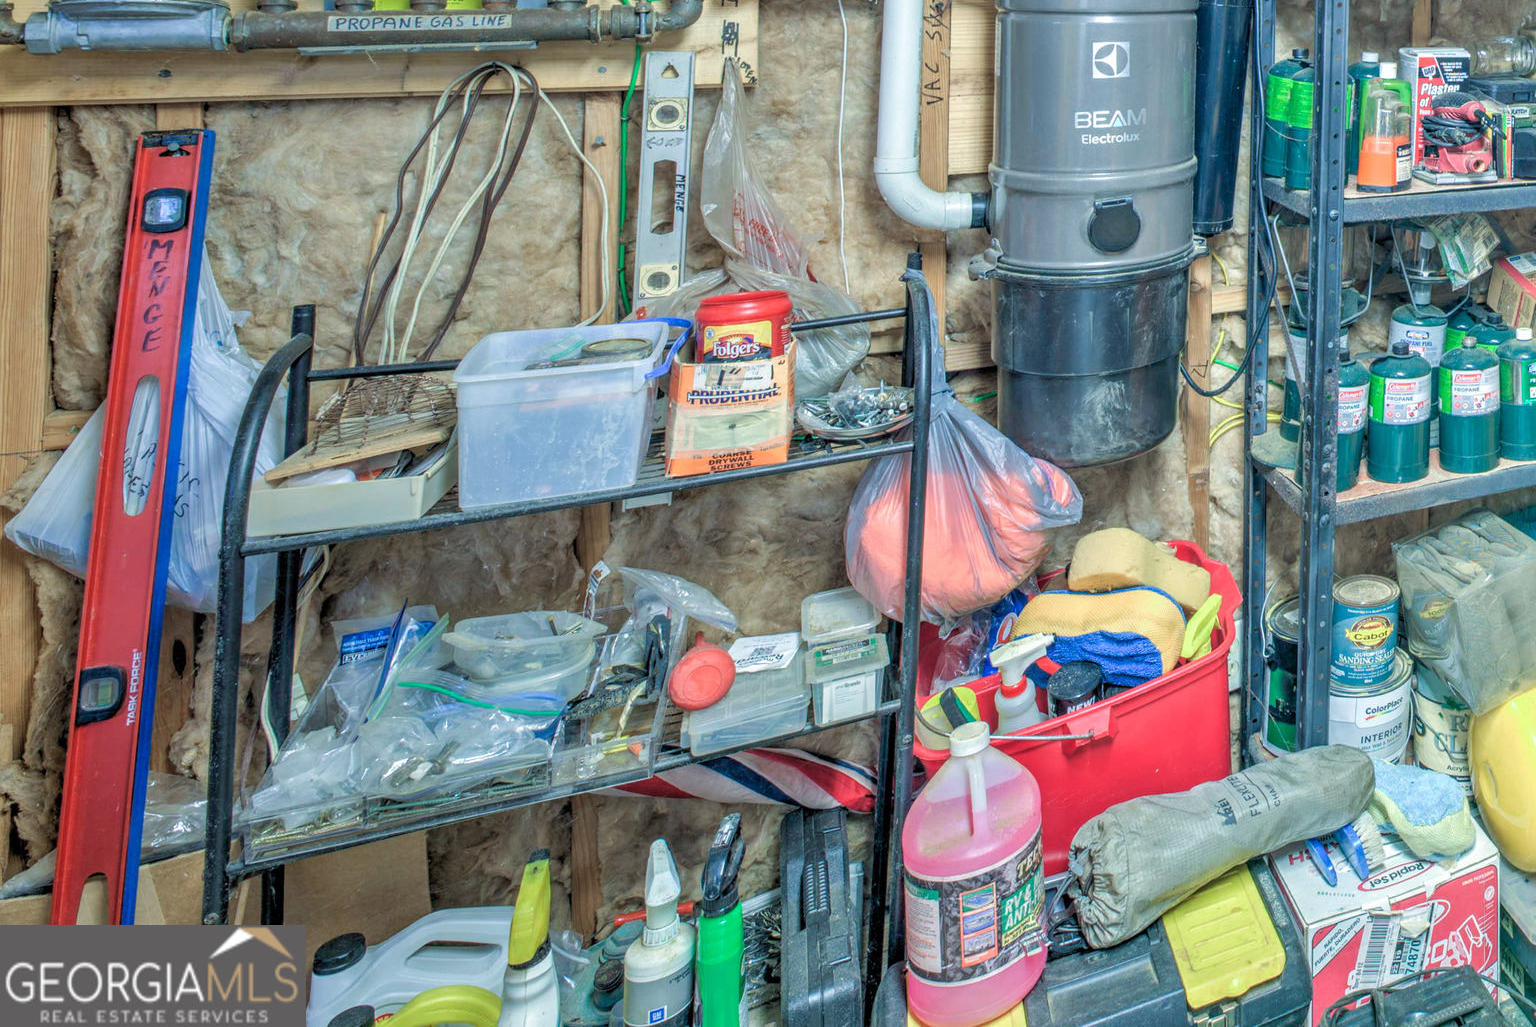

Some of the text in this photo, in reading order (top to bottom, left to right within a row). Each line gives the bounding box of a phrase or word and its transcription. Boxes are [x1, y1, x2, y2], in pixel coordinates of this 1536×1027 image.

[334, 14, 508, 31] PROPANE GAS LINE
[1424, 67, 1435, 77] DAP
[923, 62, 944, 106] VAC
[1420, 82, 1460, 97] Plaster
[1420, 96, 1430, 109] of
[1074, 108, 1147, 129] BEAM
[1081, 132, 1140, 145] Electrolux
[674, 175, 687, 213] MENGE
[143, 238, 174, 353] MENGE
[712, 340, 761, 358] Folgers
[690, 382, 780, 405] PRUDENTIAL
[708, 455, 755, 466] DRYWALL
[711, 450, 753, 459] COARSE
[710, 461, 753, 472] SCREWS
[1353, 629, 1388, 642] Cabot
[1338, 653, 1373, 665] SANDING
[126, 651, 142, 727] TASK FORCE
[1365, 696, 1404, 716] ColorPlace
[1360, 723, 1403, 745] INTERIOR
[1227, 775, 1262, 817] FLEXLITE
[1004, 884, 1031, 916] RV &
[1314, 917, 1361, 967] FUERTE, DURADERO
[1405, 939, 1422, 975] 74870
[652, 1010, 662, 1020] GM
